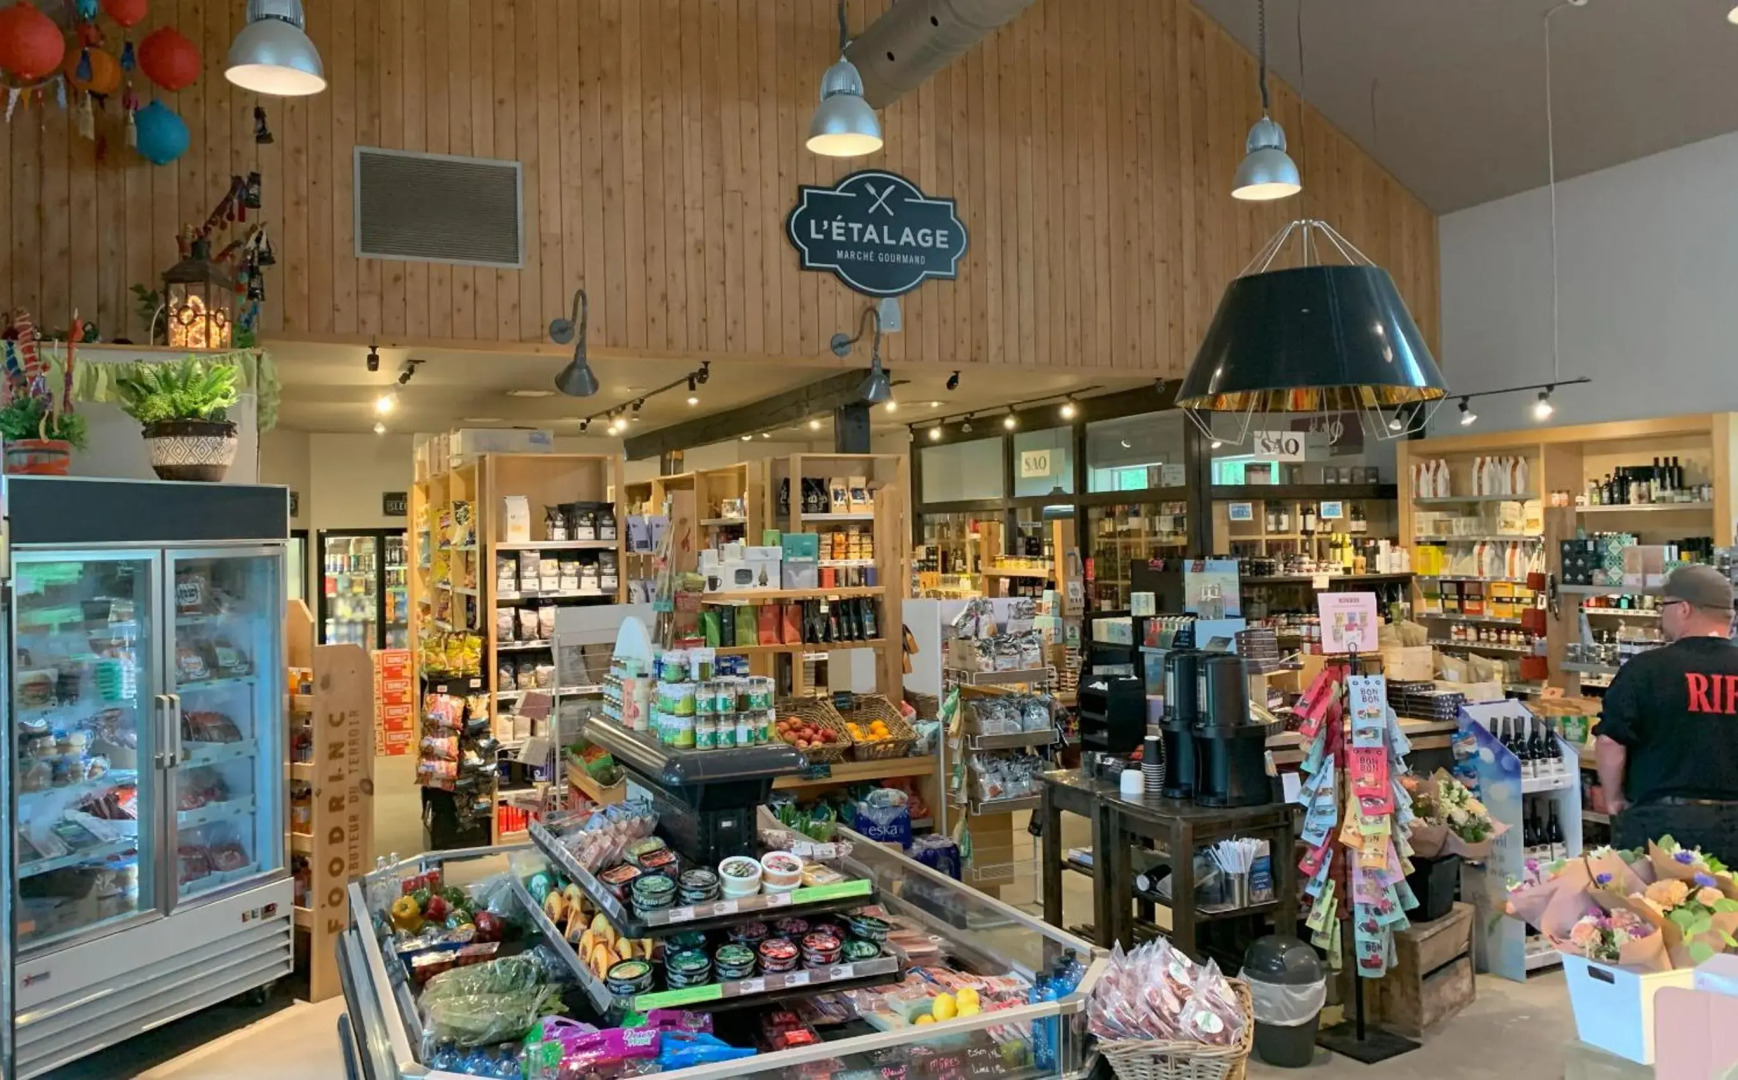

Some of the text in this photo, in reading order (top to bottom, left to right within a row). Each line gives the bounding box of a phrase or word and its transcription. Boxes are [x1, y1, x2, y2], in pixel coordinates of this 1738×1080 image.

[810, 215, 949, 249] L'ÉTALAGE
[836, 250, 926, 266] MARCHÉ GOURMAND
[1261, 438, 1300, 456] SAQ
[1361, 688, 1379, 696] BON
[1362, 695, 1380, 704] BON
[348, 710, 359, 775] TERROIR
[868, 825, 898, 836] eska
[1365, 942, 1383, 952] BON
